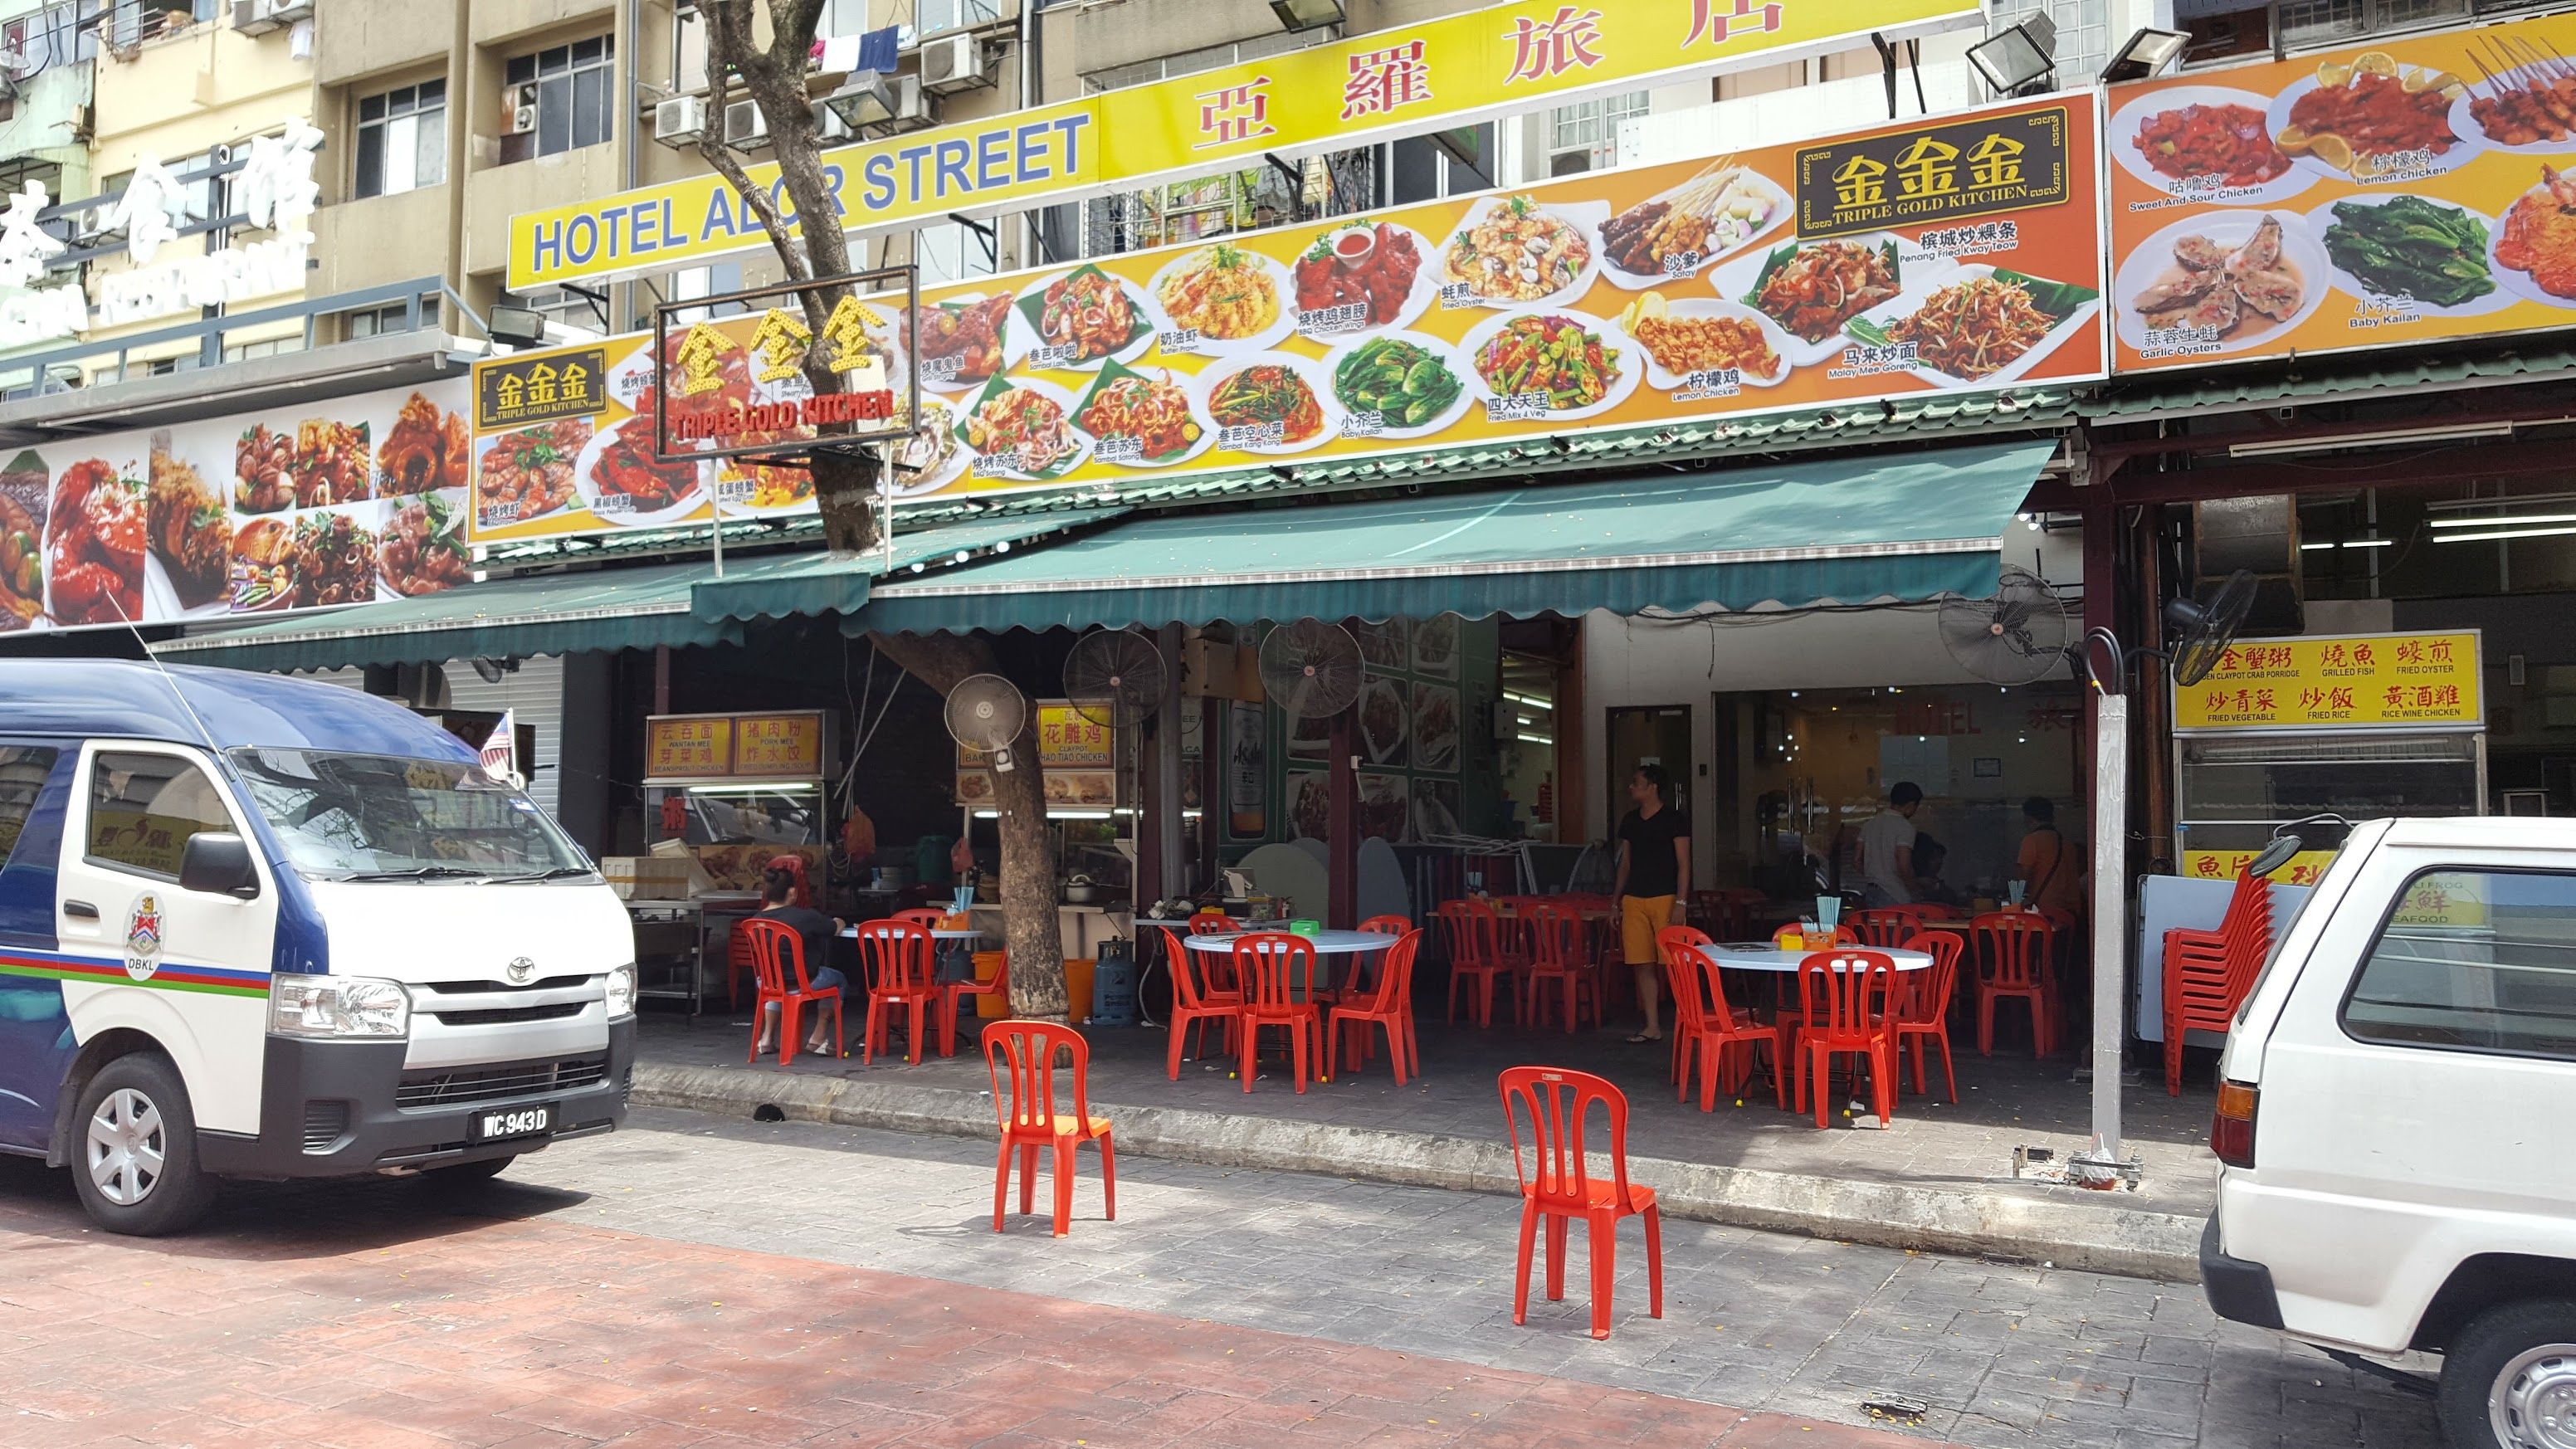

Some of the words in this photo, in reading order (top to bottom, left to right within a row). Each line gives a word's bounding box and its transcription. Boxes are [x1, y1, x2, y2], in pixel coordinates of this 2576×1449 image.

[1832, 133, 2026, 210] 金金金
[2356, 173, 2398, 185] Lemon
[2400, 166, 2447, 180] chicken
[534, 198, 688, 272] HOTEL
[862, 113, 1090, 210] STREET
[2130, 200, 2162, 212] Sweet
[2164, 196, 2186, 207] And
[2189, 192, 2215, 203] Sour
[2218, 186, 2263, 199] Chicken
[1832, 205, 1892, 224] TRIPLE
[1896, 198, 1944, 216] GOLD
[1949, 185, 2028, 208] KITCHEN
[1900, 251, 1935, 265] Penang
[1938, 247, 1961, 259] Fried
[1964, 244, 1989, 257] Kway
[1992, 240, 2017, 251] Teow
[1673, 270, 1695, 278] Satay
[1442, 300, 1460, 309] Fried
[1462, 298, 1486, 307] Oyster
[1315, 324, 1343, 334] Chicken
[1344, 320, 1364, 330] Wings
[2349, 316, 2379, 329] Baby
[2383, 313, 2420, 324] Kailan
[676, 294, 887, 396] 金金金
[1161, 346, 1178, 354] Butter
[1844, 342, 1917, 363] 马来炒面
[2140, 347, 2174, 359] Garlic
[2177, 342, 2222, 355] Oysters
[1828, 367, 1857, 379] Malay
[1859, 364, 1880, 375] Mee
[1882, 361, 1918, 374] Goreng
[496, 363, 588, 410] 金金金
[1673, 390, 1700, 401] Lemon
[1703, 386, 1739, 398] Chicken
[496, 408, 525, 421] TRIPLE
[527, 402, 549, 415] GOLD
[552, 398, 589, 412] KITCHEN
[1487, 392, 1549, 412] 四大天王
[674, 408, 742, 440] TRIPLE
[744, 400, 798, 432] GOLD
[801, 389, 894, 425] KITCHEN
[1530, 409, 1546, 418] Veg
[1341, 430, 1359, 438] Baby
[1219, 442, 1243, 451] Sambal
[1245, 441, 1261, 450] Kang
[1263, 439, 1281, 449] Kong
[1094, 456, 1117, 464] Sambal
[2320, 643, 2375, 667] 燒魚
[2217, 671, 2245, 680] CLAYPOT
[2247, 671, 2265, 679] CRAB
[2266, 670, 2300, 678] PORRIDGE
[2322, 668, 2355, 676] GRILLED
[2357, 667, 2375, 676] FISH
[2397, 666, 2420, 675] FRIED
[2422, 665, 2454, 674] OYSTER
[2205, 688, 2277, 712] 炒青菜
[2298, 686, 2357, 710] 炒飯
[2308, 711, 2330, 720] FRIED
[2332, 710, 2350, 719] RICE
[2382, 710, 2400, 718] RICE
[1076, 753, 1107, 761] CHICKEN
[2393, 915, 2448, 924] EAFOOD
[129, 959, 154, 971] DBKL
